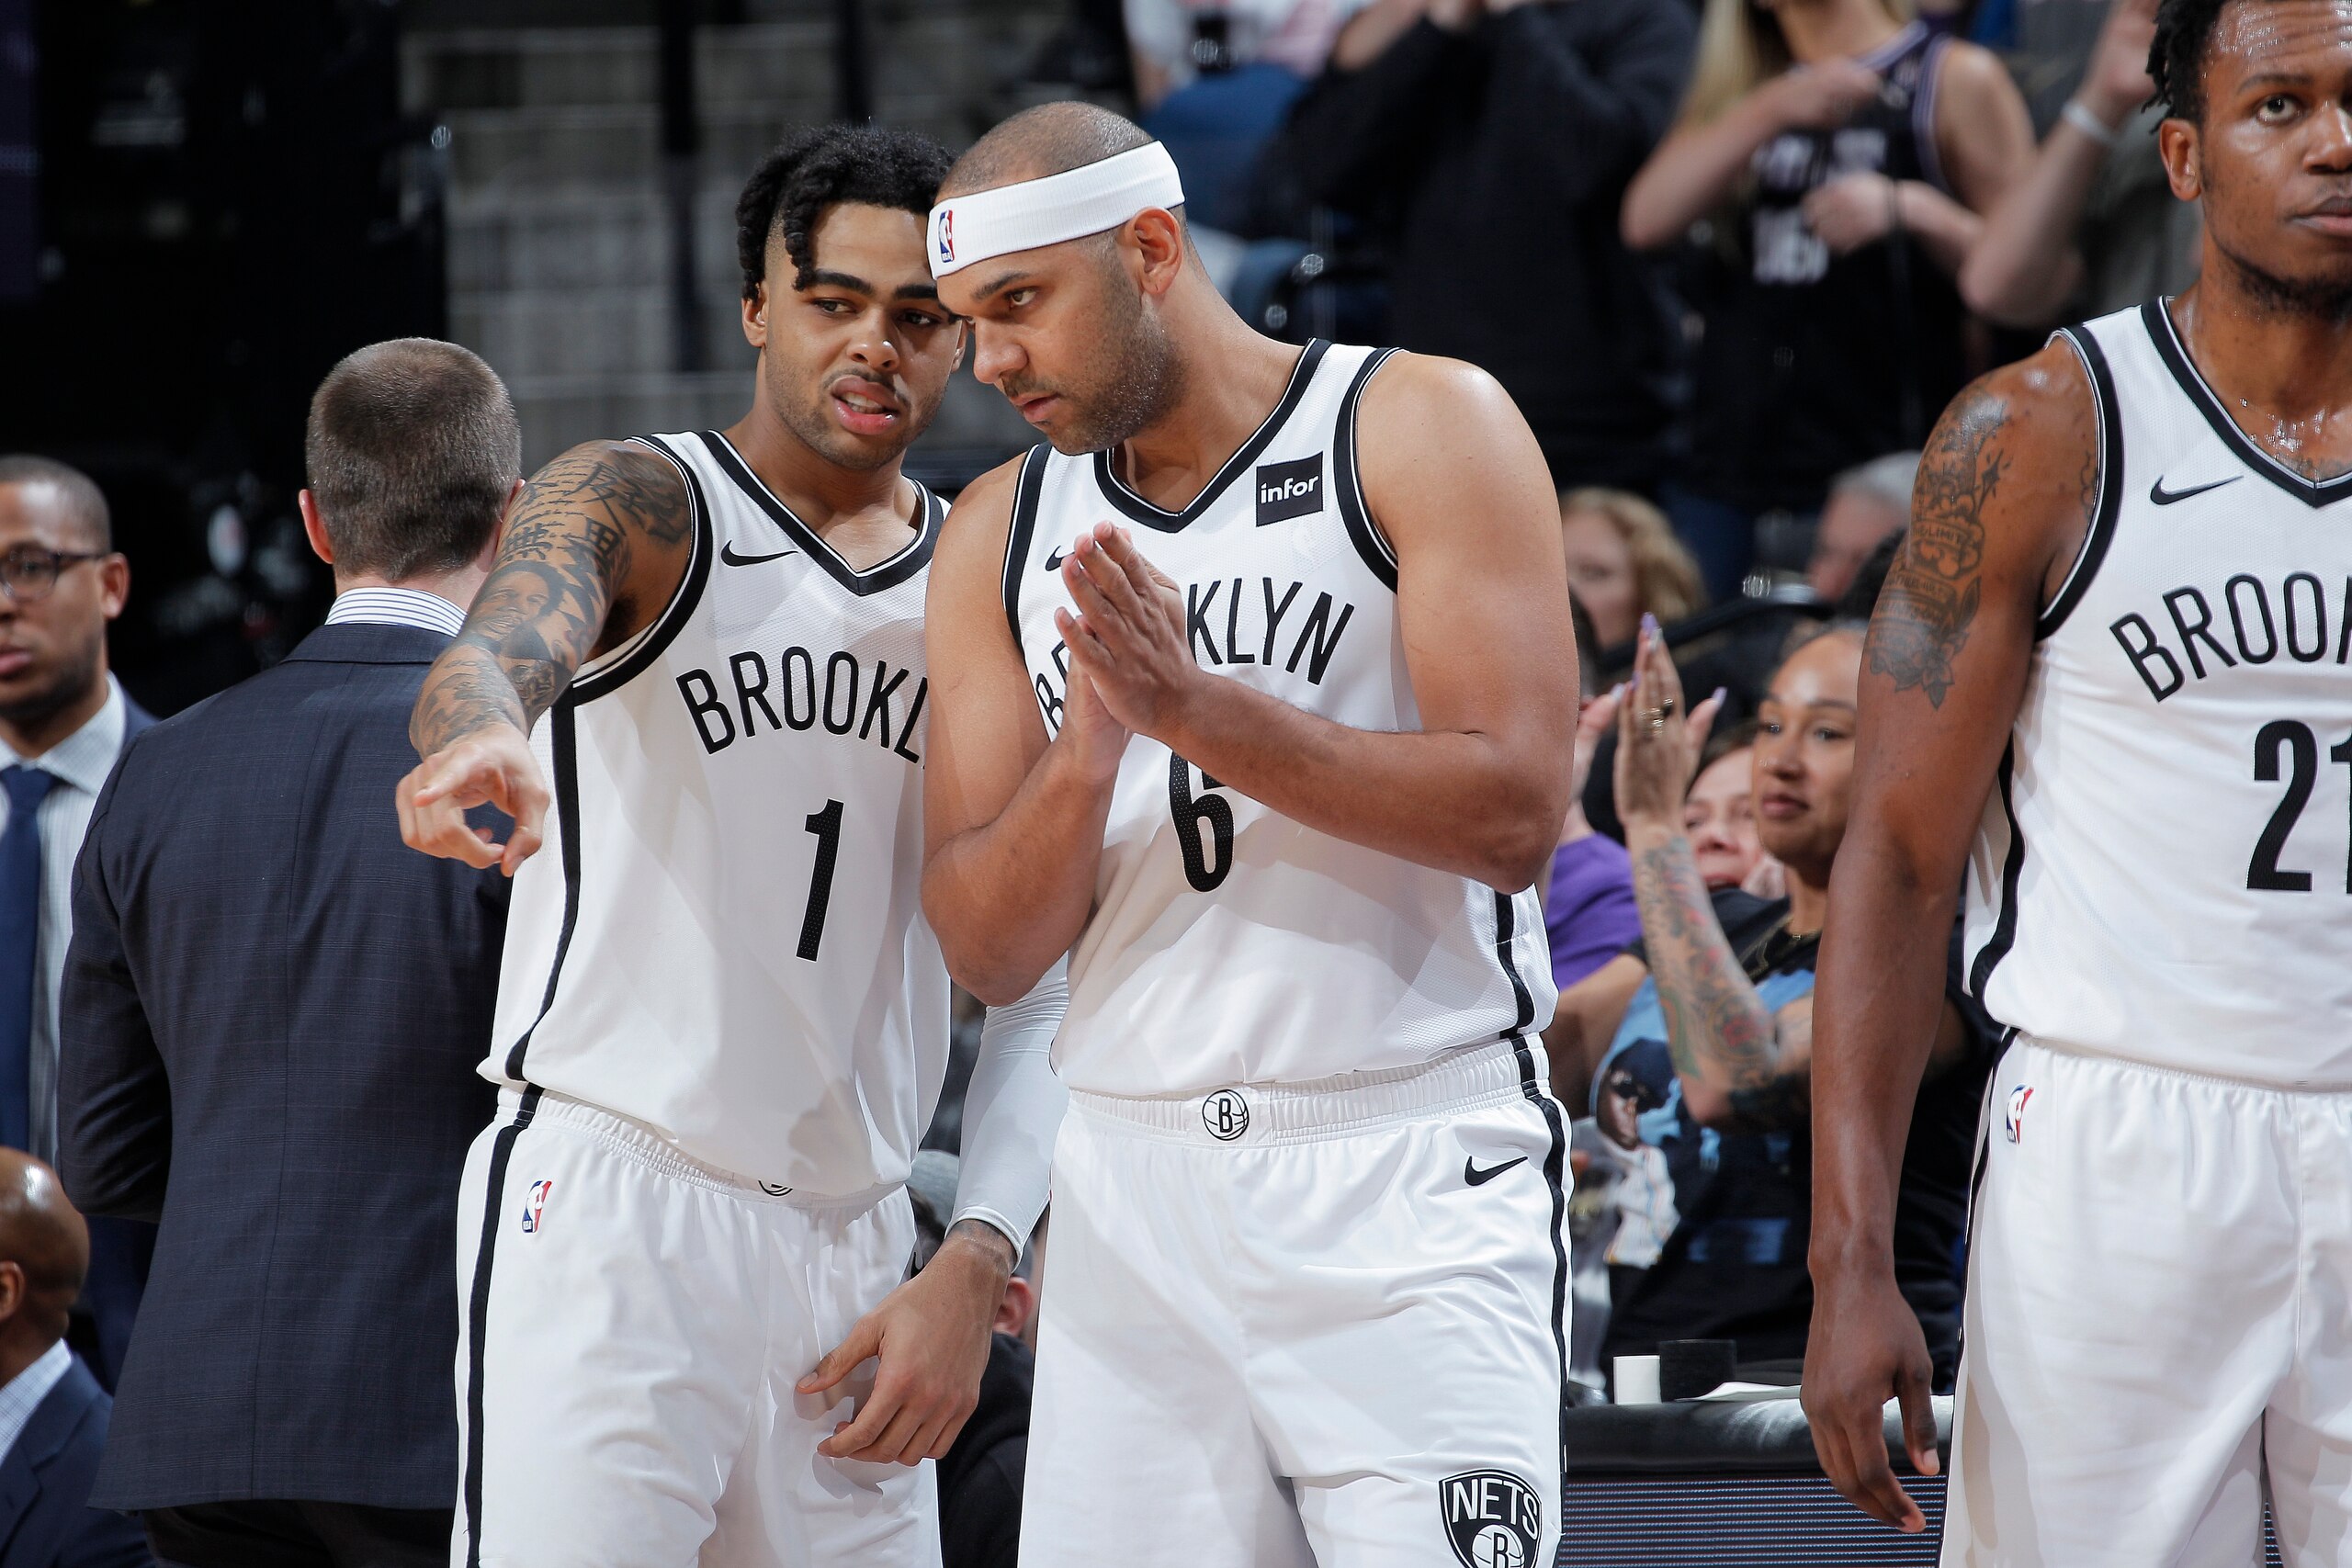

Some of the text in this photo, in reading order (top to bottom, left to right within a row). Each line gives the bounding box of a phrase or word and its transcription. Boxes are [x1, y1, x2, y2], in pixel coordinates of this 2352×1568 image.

[1261, 475, 1319, 504] infor
[1035, 577, 1354, 733] BKLYN
[2109, 572, 2352, 703] BROO
[675, 646, 928, 769] BROOKL
[796, 798, 844, 962] 1
[1169, 750, 1234, 893] 6
[1453, 1478, 1538, 1540] NETS
